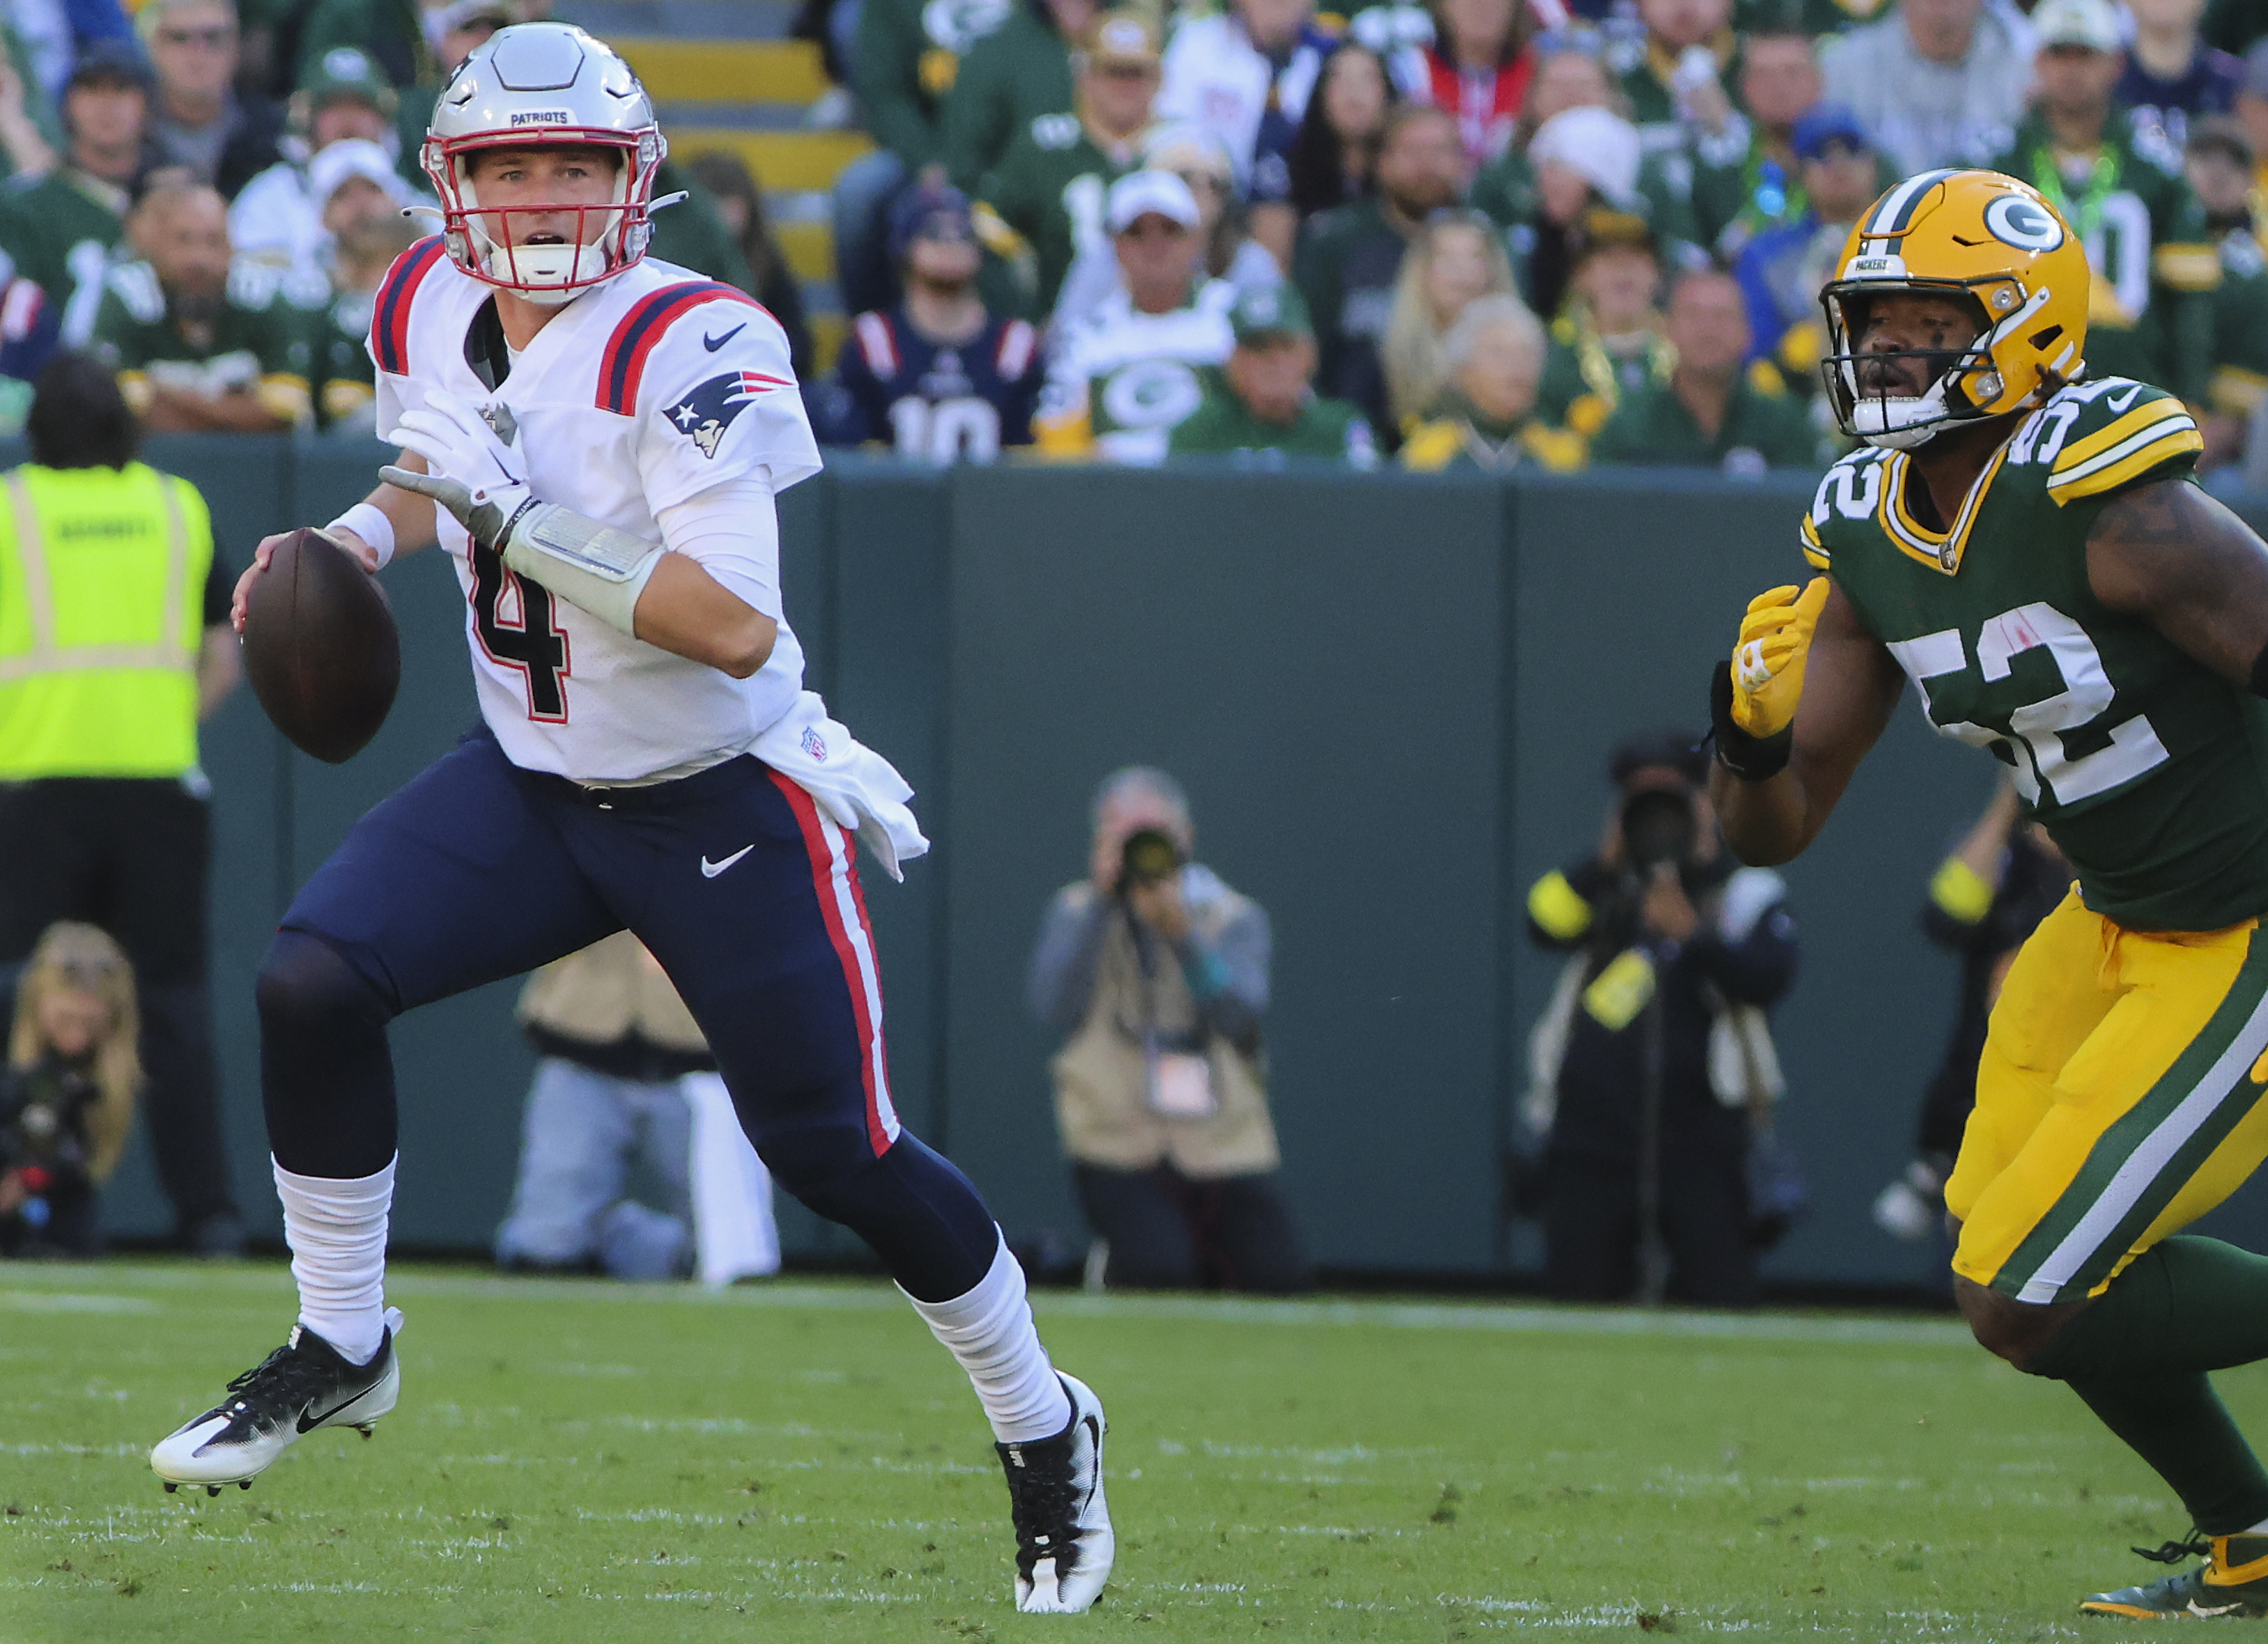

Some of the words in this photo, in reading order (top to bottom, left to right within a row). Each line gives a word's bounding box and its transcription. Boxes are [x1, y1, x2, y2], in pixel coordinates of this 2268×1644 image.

[511, 111, 568, 126] PATRIOTS
[1982, 194, 2064, 252] G
[1855, 258, 1888, 272] PACKERS
[467, 533, 571, 724] 4
[1885, 601, 2170, 808] 52
